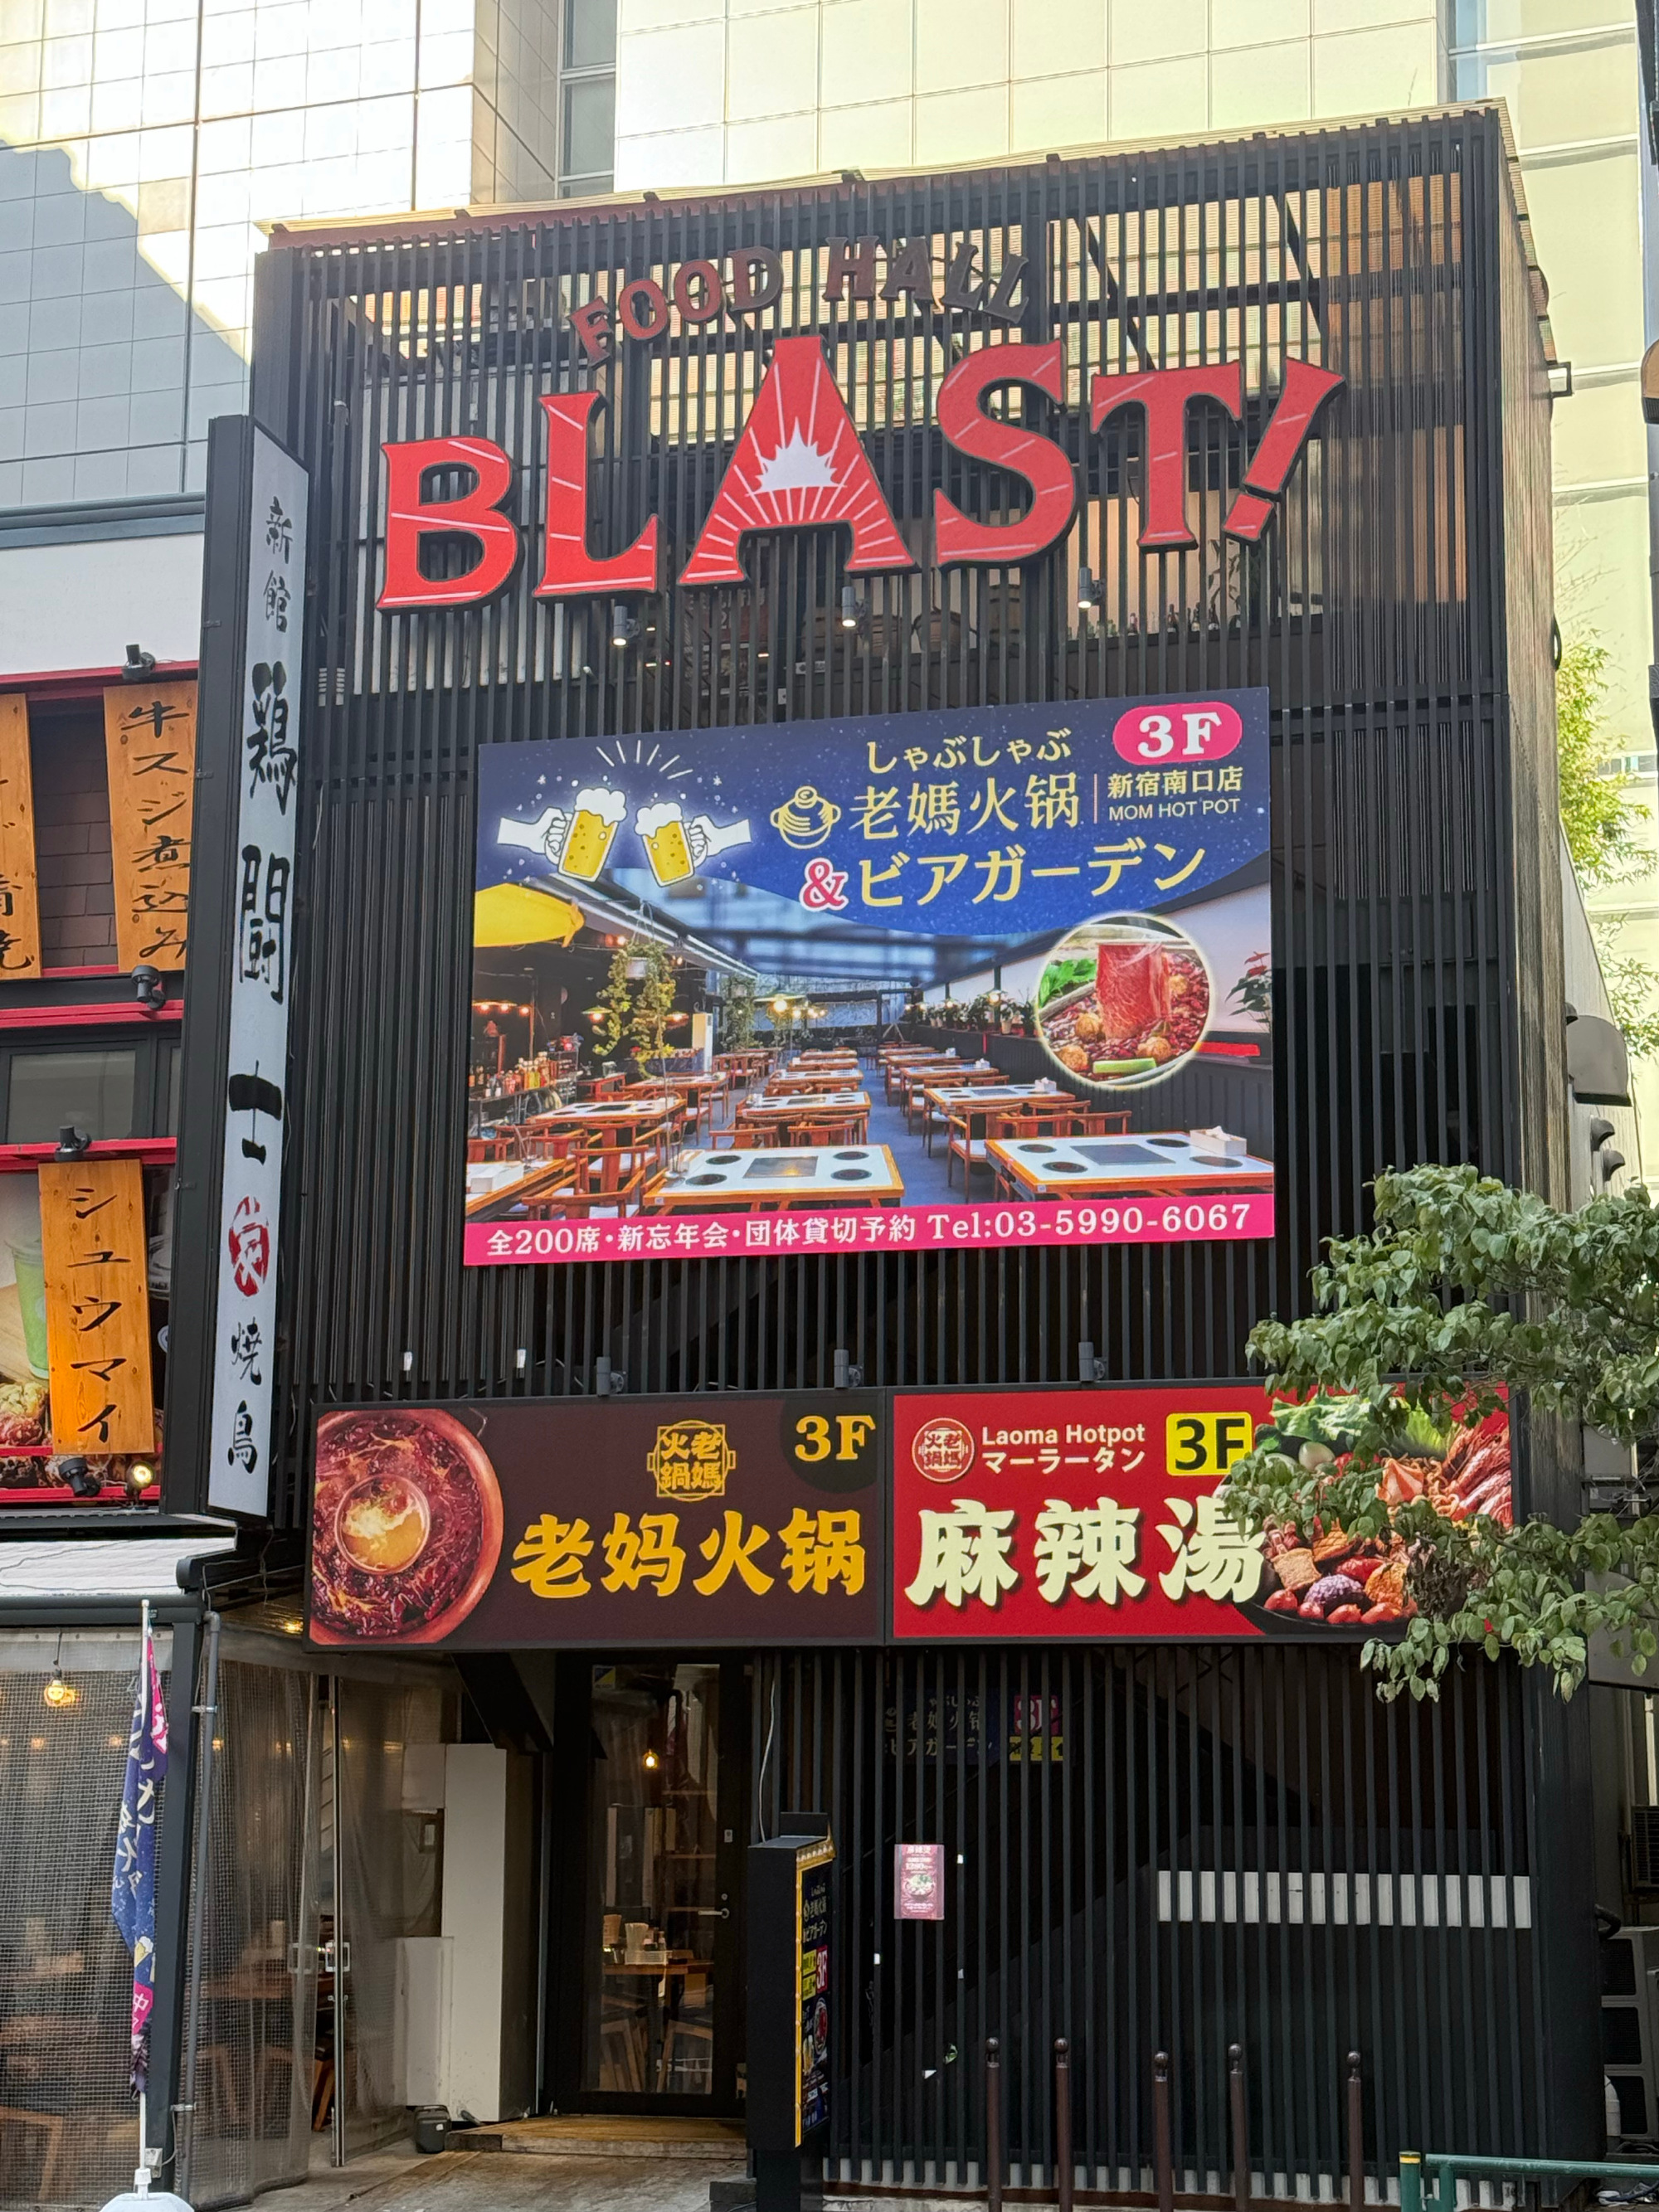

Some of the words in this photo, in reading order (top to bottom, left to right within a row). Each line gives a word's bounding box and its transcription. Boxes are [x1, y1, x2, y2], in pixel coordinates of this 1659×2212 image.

[567, 246, 784, 370] FOOD
[823, 236, 1032, 325] HALL
[376, 334, 1345, 611] BLAST!
[867, 727, 1072, 774] しゃぶしゃぶ
[1137, 712, 1222, 757] 3F
[1107, 766, 1243, 800] 新宿南口店
[1108, 804, 1153, 821] MOM
[1159, 800, 1198, 819] HOT
[1203, 798, 1240, 815] POT
[121, 701, 191, 959] 牛スジ煮込み
[66, 1188, 131, 1443] シュウマイ
[228, 1316, 262, 1474] 焼鳥
[794, 1414, 876, 1462] 3F
[982, 1426, 1058, 1446] Laoma
[1066, 1423, 1145, 1446] Hotpot
[982, 1448, 1146, 1474] マーラータン
[1175, 1417, 1245, 1471] 3F
[510, 1507, 866, 1599] 老妈火锅
[904, 1496, 1266, 1607] 麻辣湯
